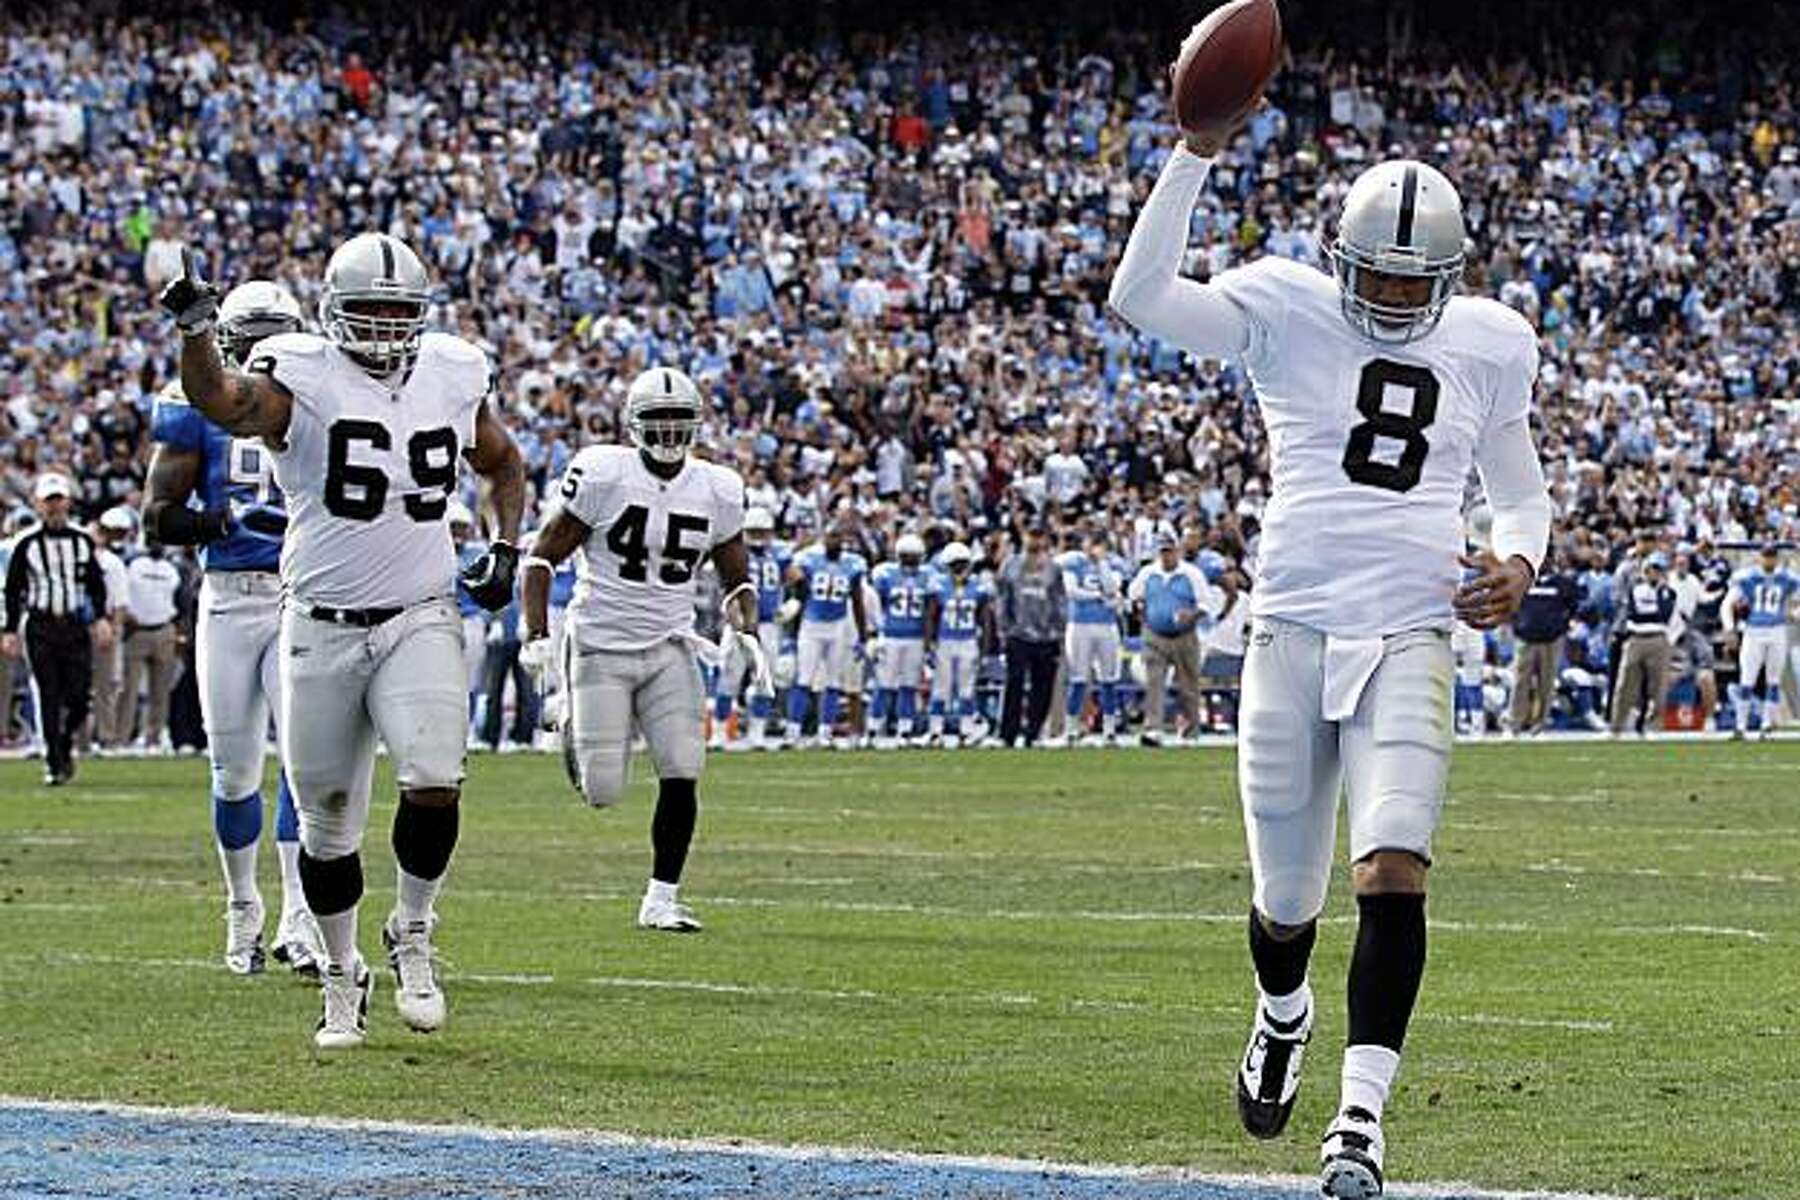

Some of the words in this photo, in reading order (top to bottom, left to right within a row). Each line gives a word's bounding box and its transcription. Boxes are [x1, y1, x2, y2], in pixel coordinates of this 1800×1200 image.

[1342, 358, 1441, 494] 8
[323, 419, 459, 522] 69
[606, 505, 711, 584] 45
[889, 587, 926, 618] 35
[1755, 584, 1782, 613] 10
